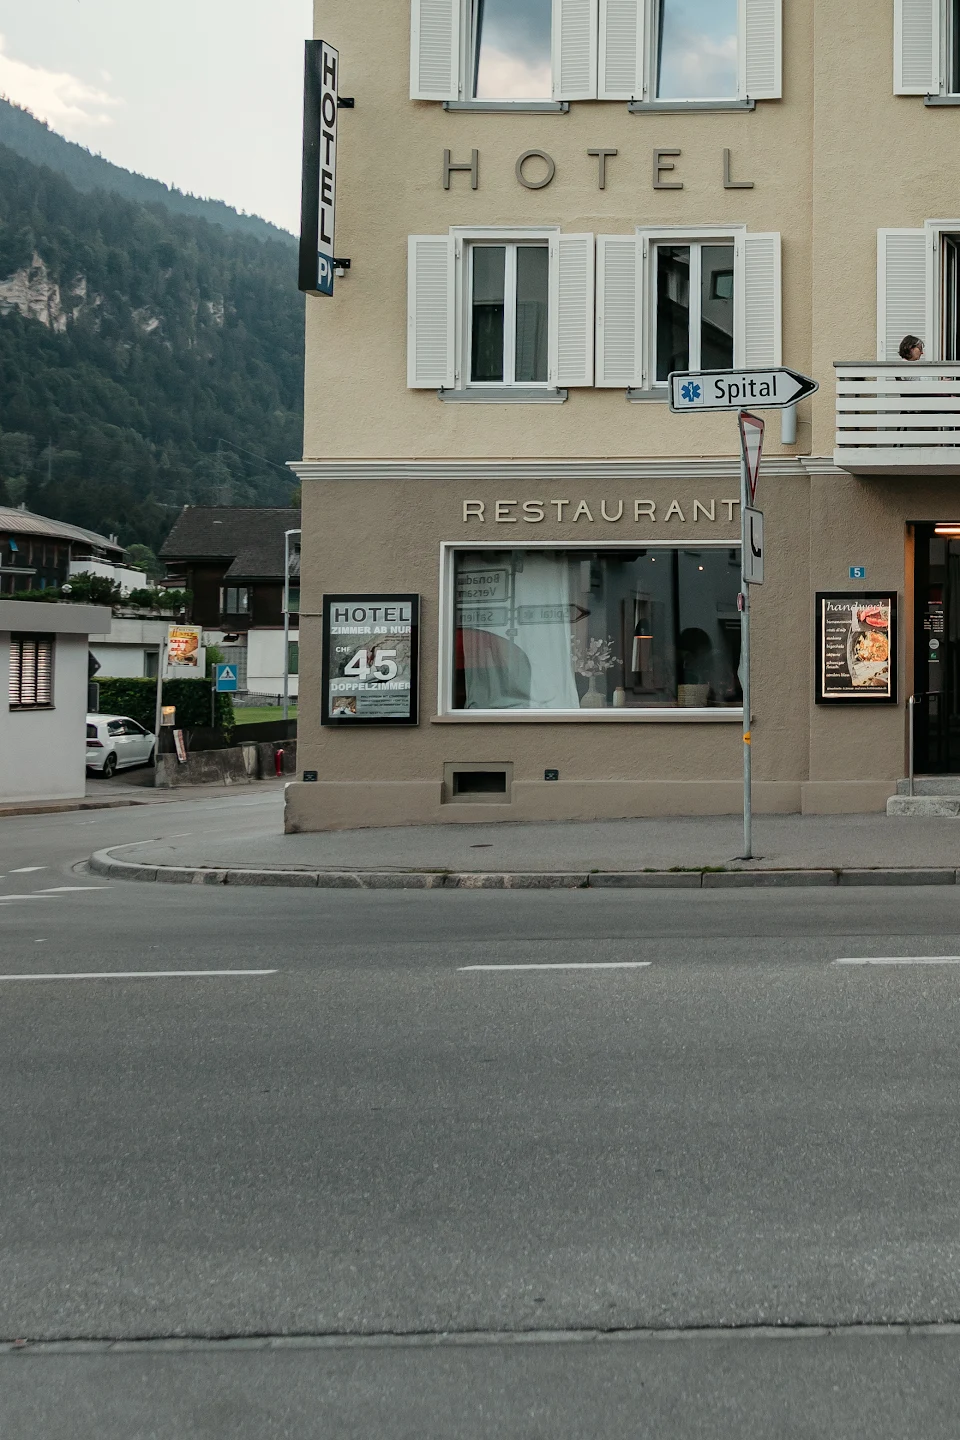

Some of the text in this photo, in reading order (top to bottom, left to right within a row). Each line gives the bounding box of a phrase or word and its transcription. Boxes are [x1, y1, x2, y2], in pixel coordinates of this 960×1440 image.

[320, 51, 337, 245] HOTEL
[443, 148, 754, 189] HOTEL
[318, 256, 328, 285] P
[715, 375, 778, 404] Spital
[462, 499, 741, 523] RESTAURANT
[854, 567, 861, 578] 5
[334, 607, 410, 622] HOTEL
[331, 625, 411, 634] ZIMMER AB NUR
[344, 649, 398, 681] 45
[330, 682, 411, 691] DOPPELZIMMER
